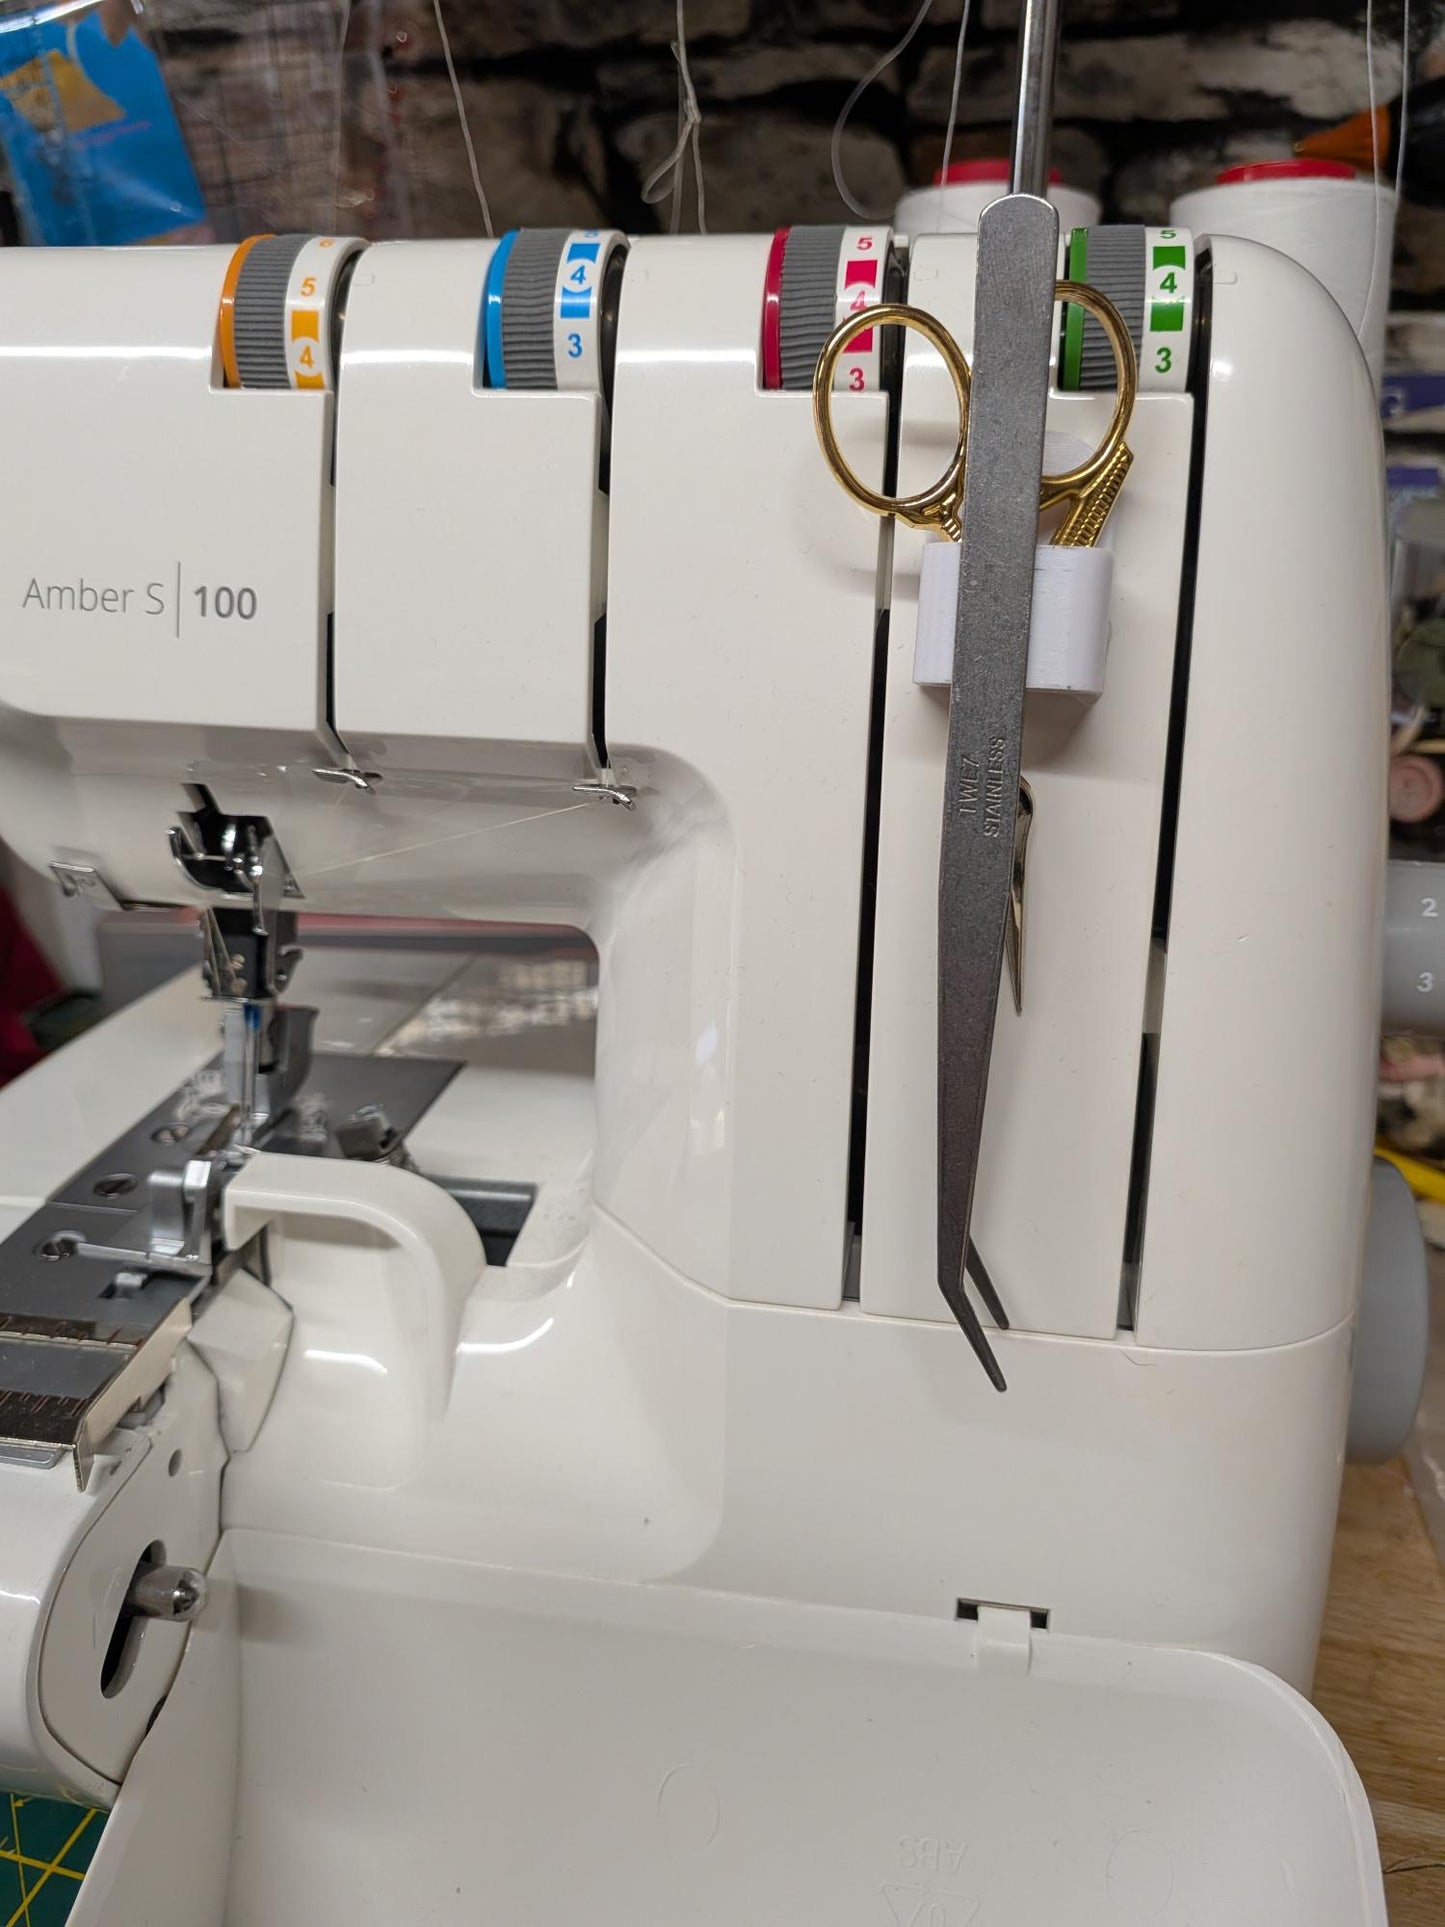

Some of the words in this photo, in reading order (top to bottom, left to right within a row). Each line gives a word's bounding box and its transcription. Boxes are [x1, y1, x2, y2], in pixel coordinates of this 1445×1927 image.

[856, 237, 873, 250] 5
[300, 276, 316, 297] 5
[570, 265, 586, 285] 4
[1159, 272, 1177, 294] 4
[300, 345, 314, 369] 4
[568, 333, 583, 358] 3
[1155, 346, 1172, 374] 3
[848, 367, 865, 391] 3
[22, 577, 135, 613] Amber
[145, 582, 165, 616] S
[194, 585, 258, 621] 100
[983, 736, 1006, 838] STAINLESS
[1421, 897, 1438, 918] 2
[1416, 971, 1434, 993] 3
